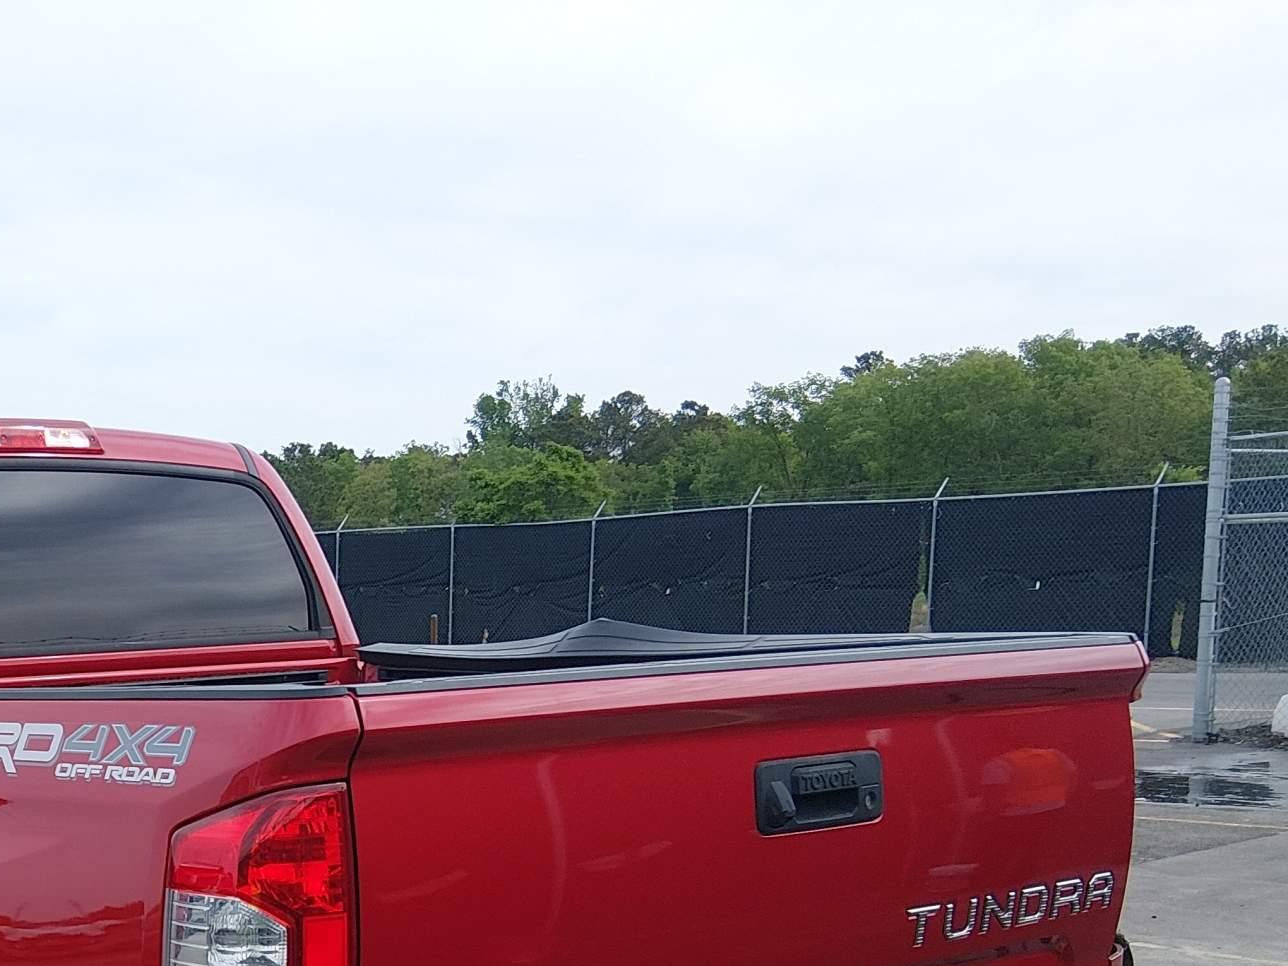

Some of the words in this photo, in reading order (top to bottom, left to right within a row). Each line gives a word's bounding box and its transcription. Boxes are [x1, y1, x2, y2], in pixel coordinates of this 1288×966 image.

[62, 724, 195, 767] 4X4
[54, 763, 103, 782] OFF
[103, 765, 176, 787] ROAD
[800, 769, 857, 792] TOYOTA
[906, 871, 1114, 948] TUNDRA
